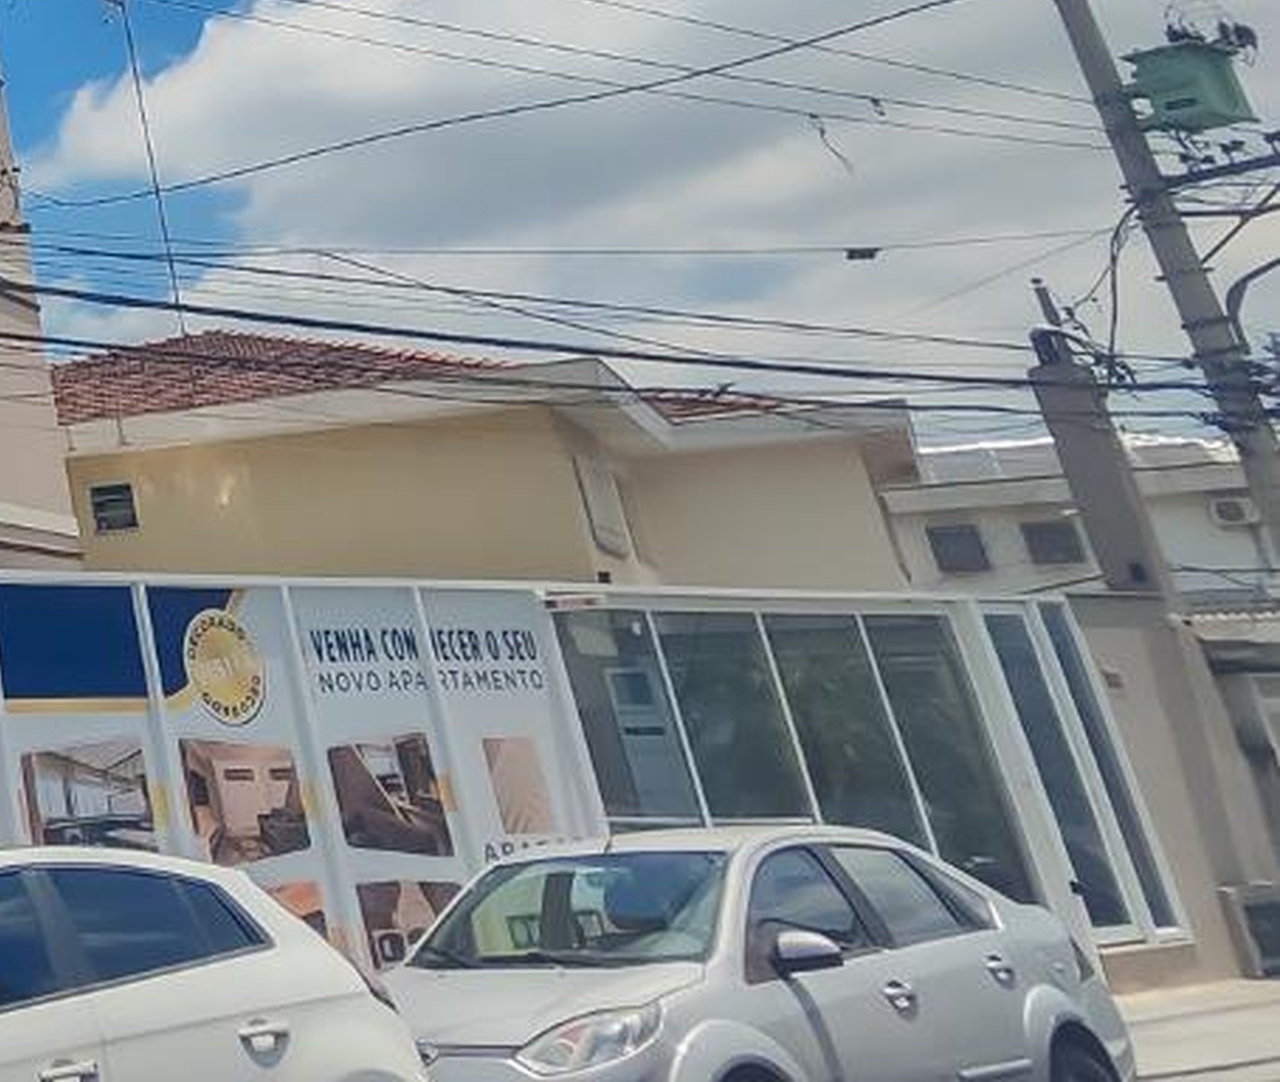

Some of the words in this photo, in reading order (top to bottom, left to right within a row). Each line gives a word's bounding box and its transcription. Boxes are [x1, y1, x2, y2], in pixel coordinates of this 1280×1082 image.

[310, 629, 377, 662] VENHA
[485, 630, 500, 661] O
[502, 630, 537, 661] SEU
[319, 670, 381, 693] NOVO
